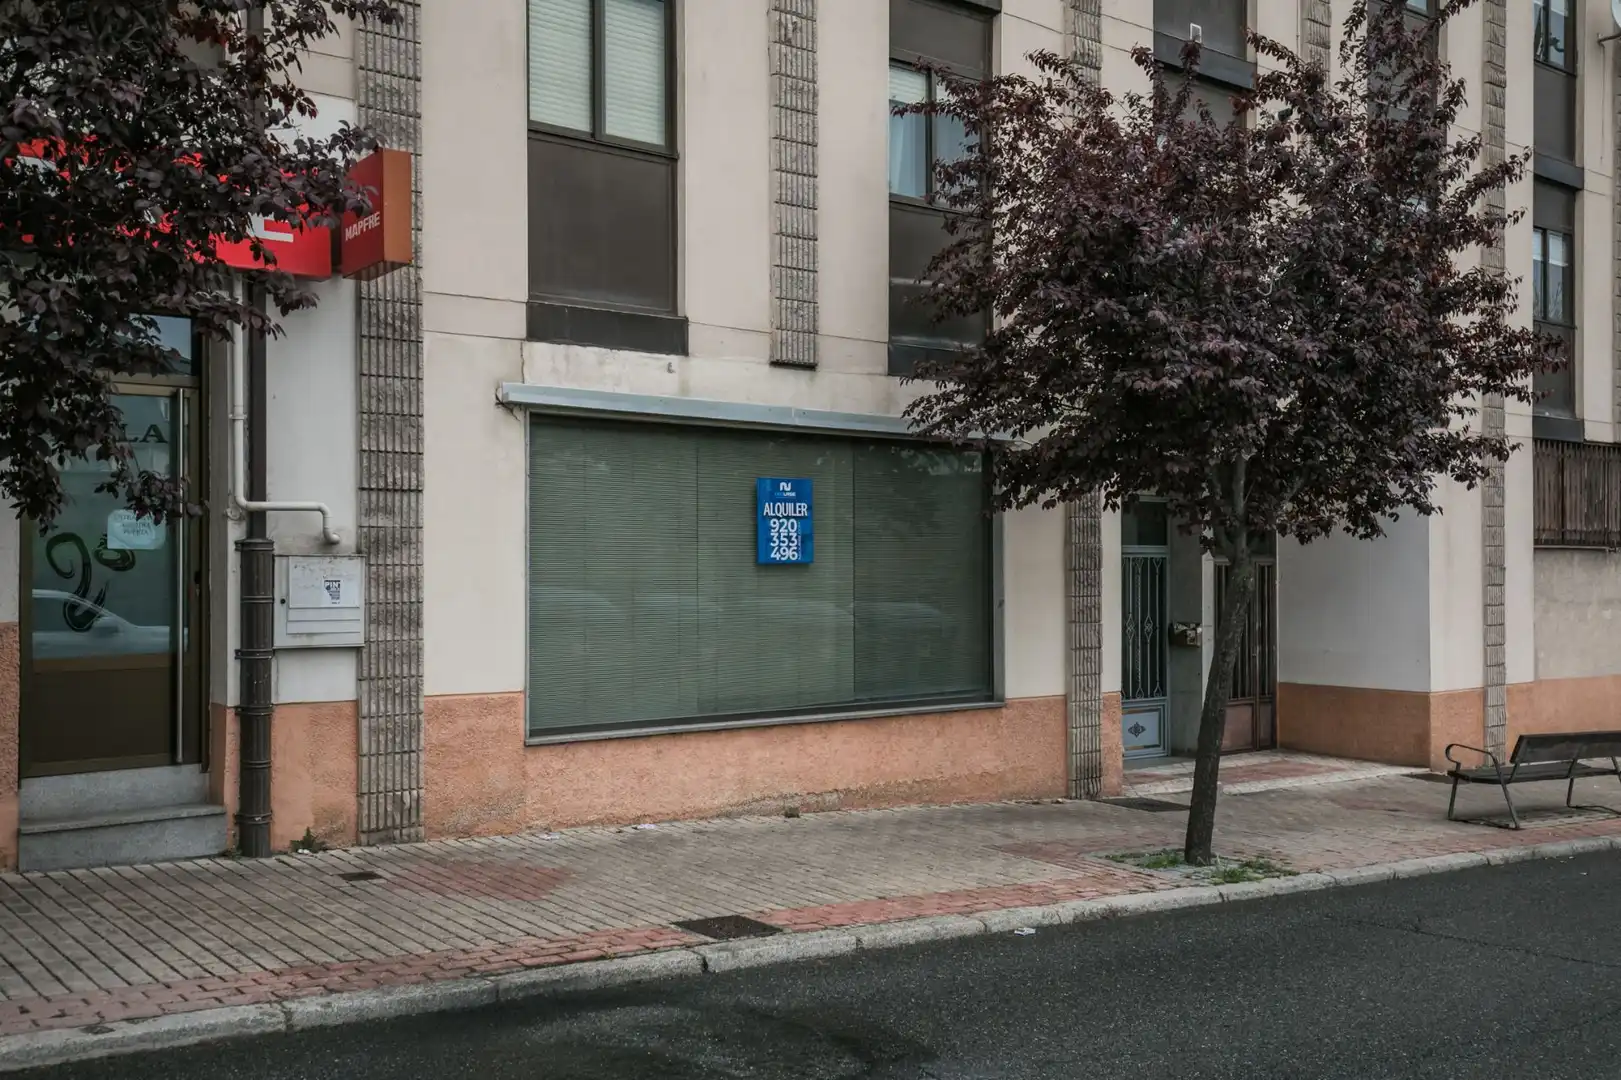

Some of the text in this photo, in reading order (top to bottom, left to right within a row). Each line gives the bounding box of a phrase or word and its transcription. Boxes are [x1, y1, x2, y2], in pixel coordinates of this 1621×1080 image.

[345, 212, 380, 241] MAPFRE
[763, 502, 808, 517] ALQUILER
[770, 518, 798, 533] 920
[770, 532, 798, 547] 353
[770, 546, 798, 561] 496
